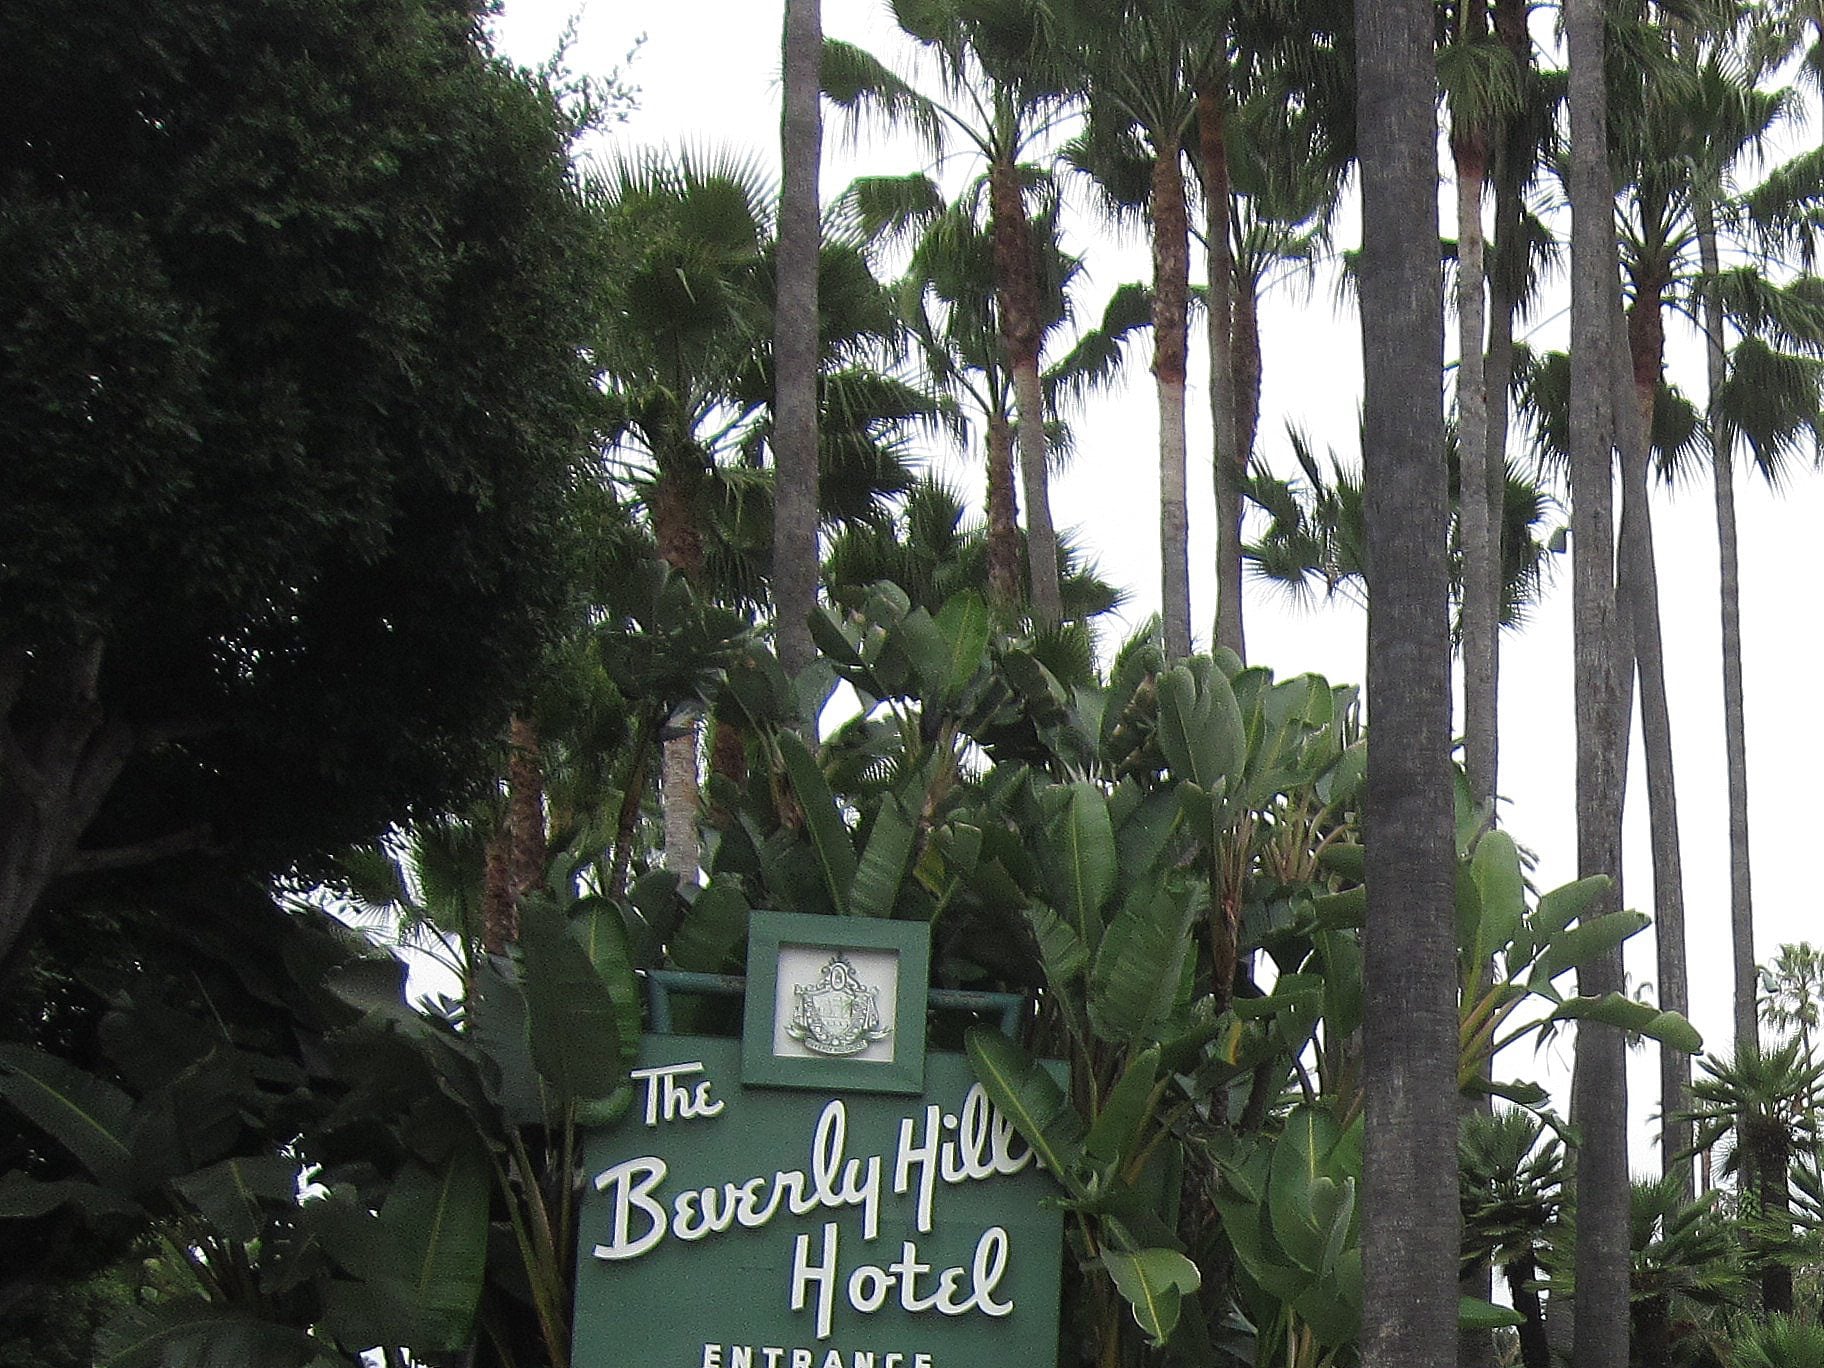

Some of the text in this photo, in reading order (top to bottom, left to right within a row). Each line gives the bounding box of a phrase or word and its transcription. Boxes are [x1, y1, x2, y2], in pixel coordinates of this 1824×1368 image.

[629, 1061, 725, 1126] The
[593, 1081, 1048, 1261] Beverly Hill
[790, 1222, 1015, 1340] Hotel
